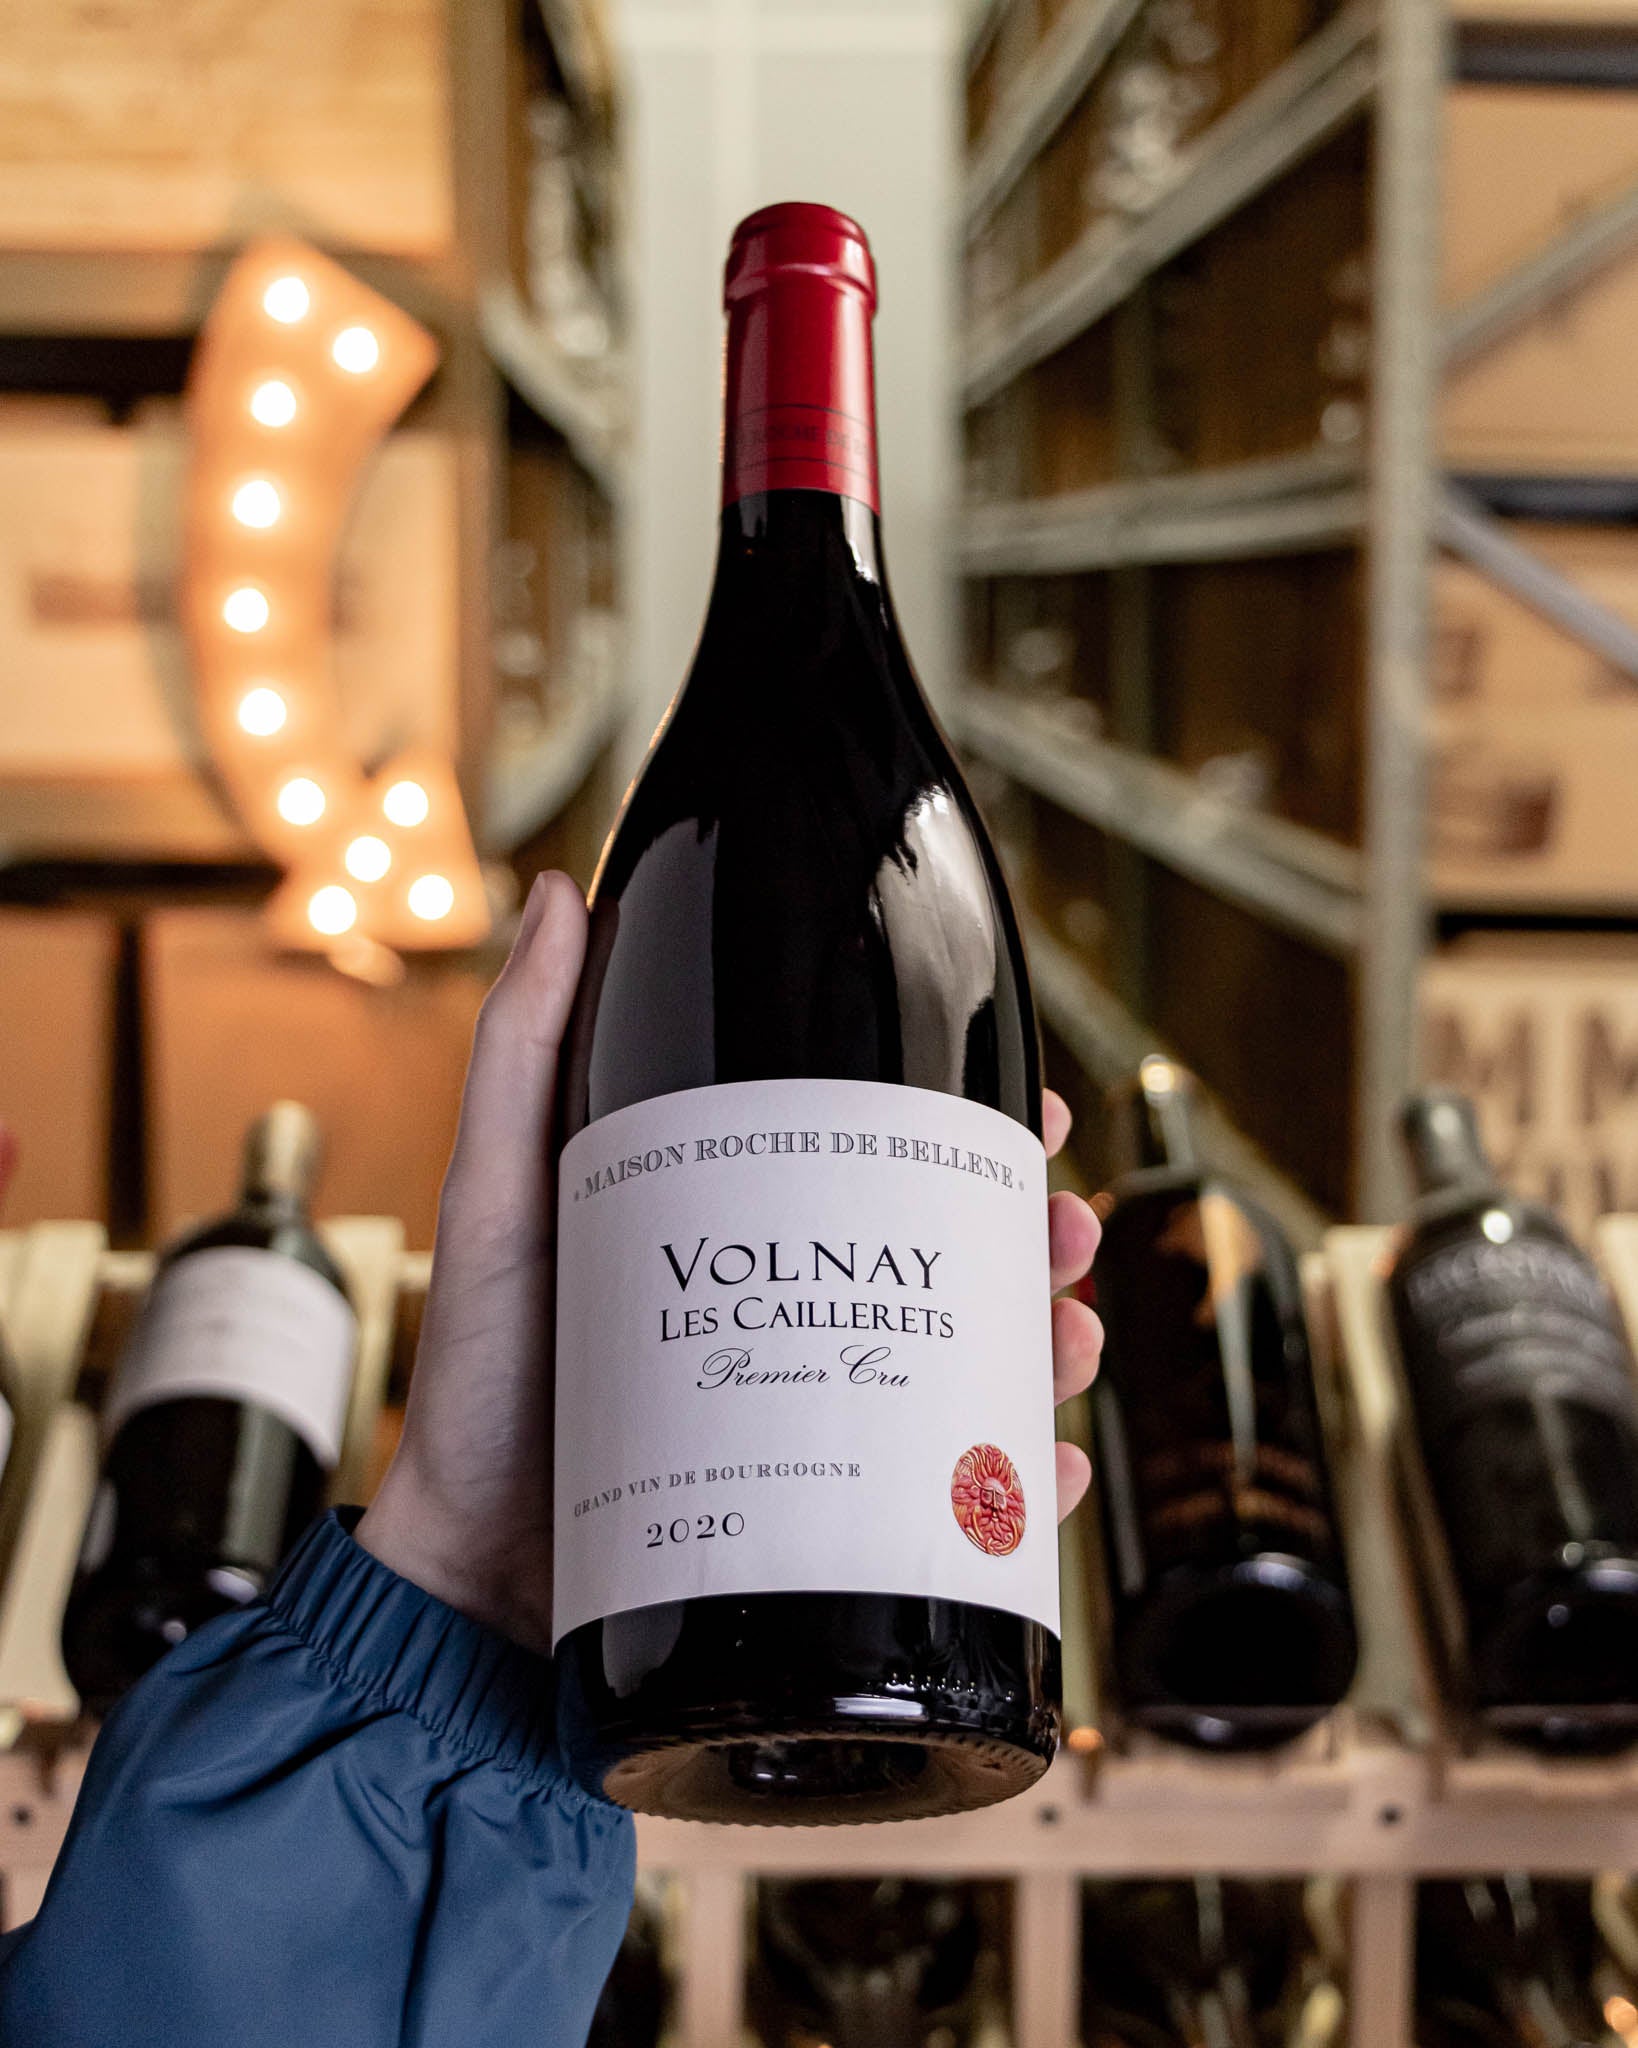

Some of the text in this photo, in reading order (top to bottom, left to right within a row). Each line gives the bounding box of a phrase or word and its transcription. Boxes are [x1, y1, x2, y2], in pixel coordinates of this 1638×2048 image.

[584, 1131, 1013, 1200] MAISON ROCHE DE BELLENE
[659, 1236, 942, 1292] VOLNAY
[660, 1296, 954, 1342] LES CAILLERETS
[696, 1344, 910, 1390] Premier Cru
[573, 1462, 861, 1518] GRAND VIN DE BOURGOGNE
[646, 1511, 745, 1549] 2020
